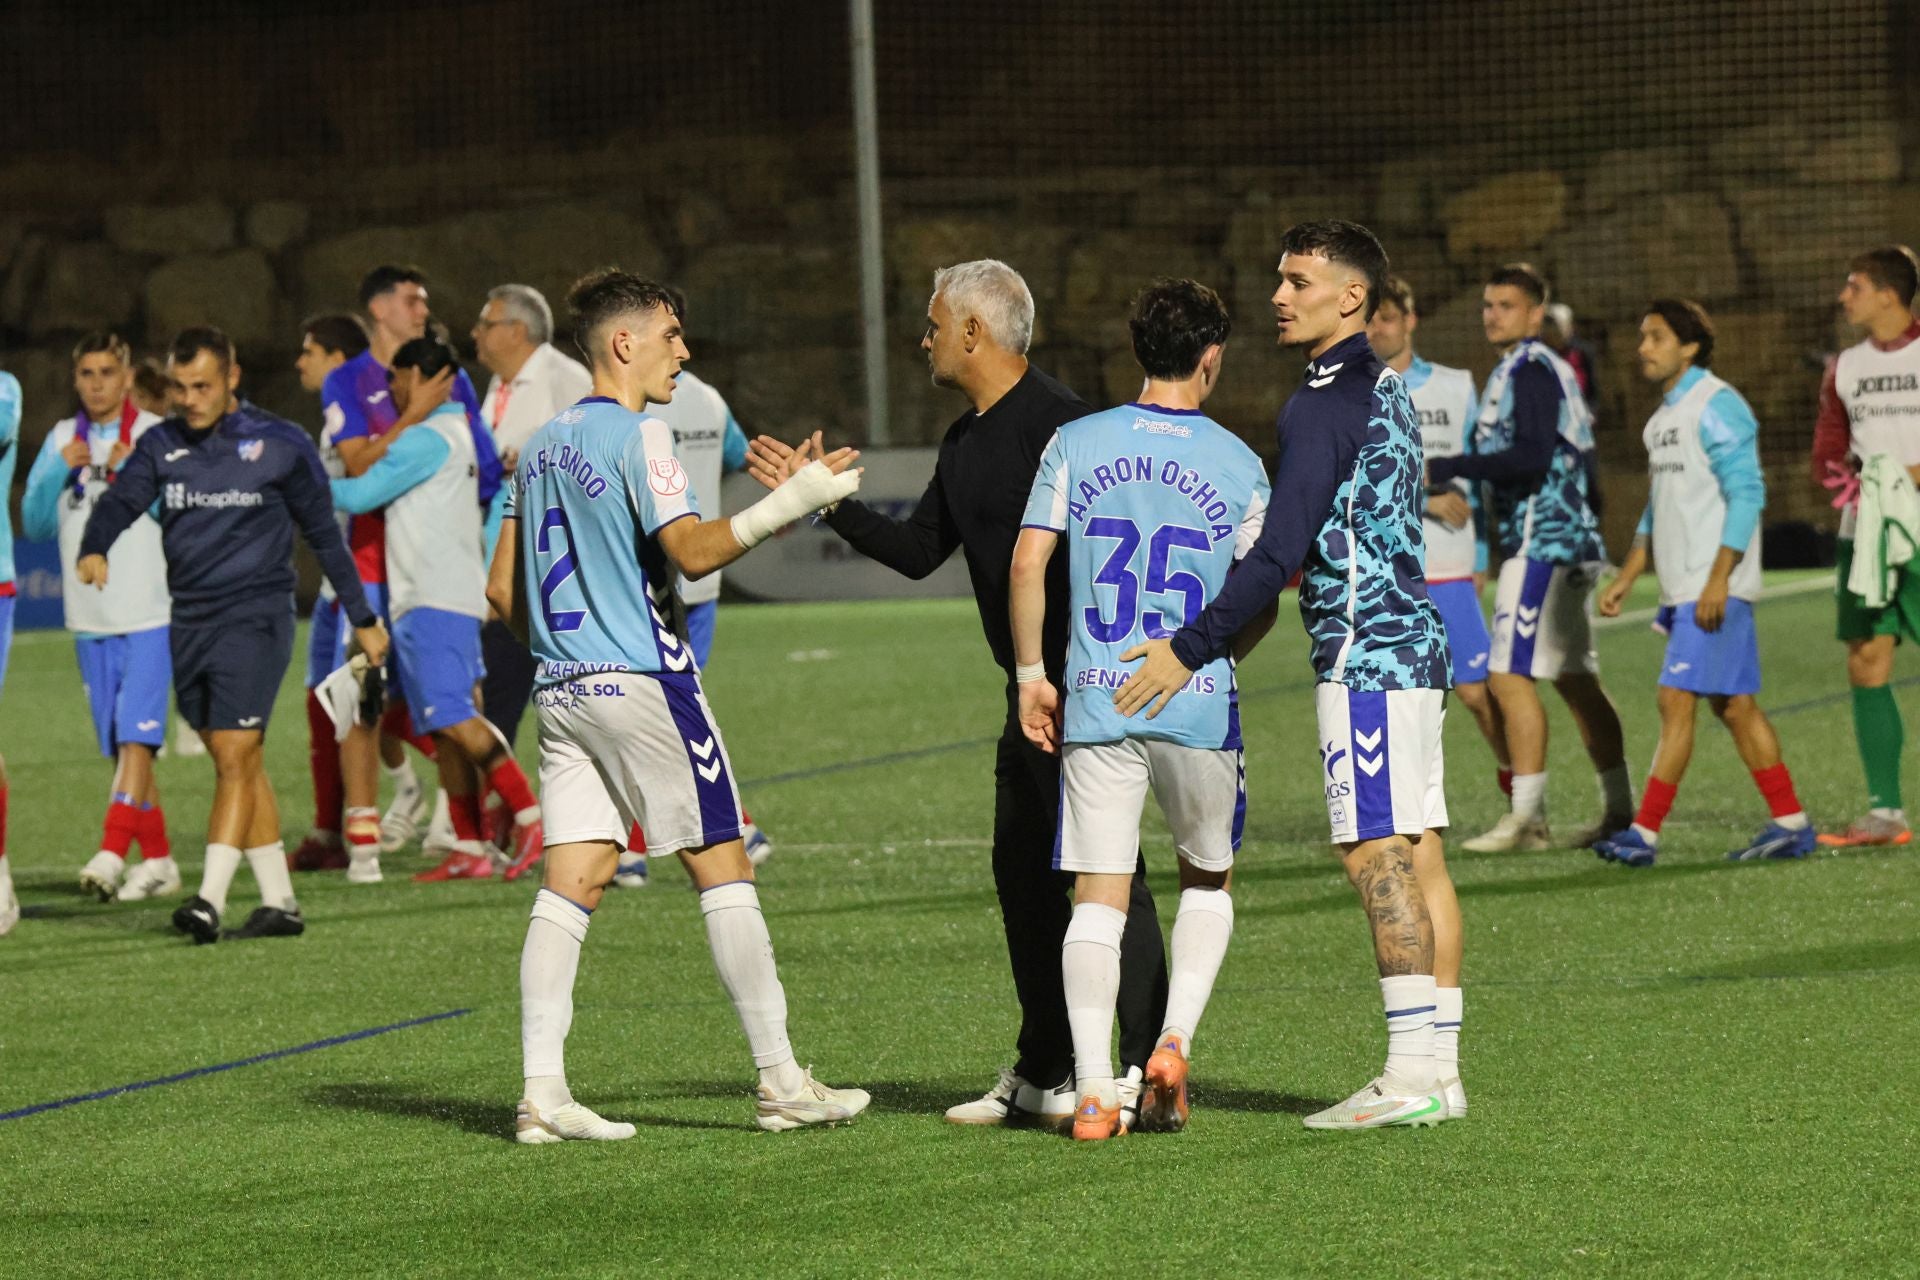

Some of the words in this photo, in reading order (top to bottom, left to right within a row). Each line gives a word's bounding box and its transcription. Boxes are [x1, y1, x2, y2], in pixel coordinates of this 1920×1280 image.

[186, 488, 263, 510] Hospiten
[519, 443, 608, 500] ABLONDO
[1068, 455, 1154, 524] AARON
[1160, 459, 1234, 544] OCHOA
[536, 506, 589, 633] 2
[1082, 515, 1214, 644] 35
[594, 683, 626, 697] SOL
[1076, 669, 1216, 695] BENAVIS
